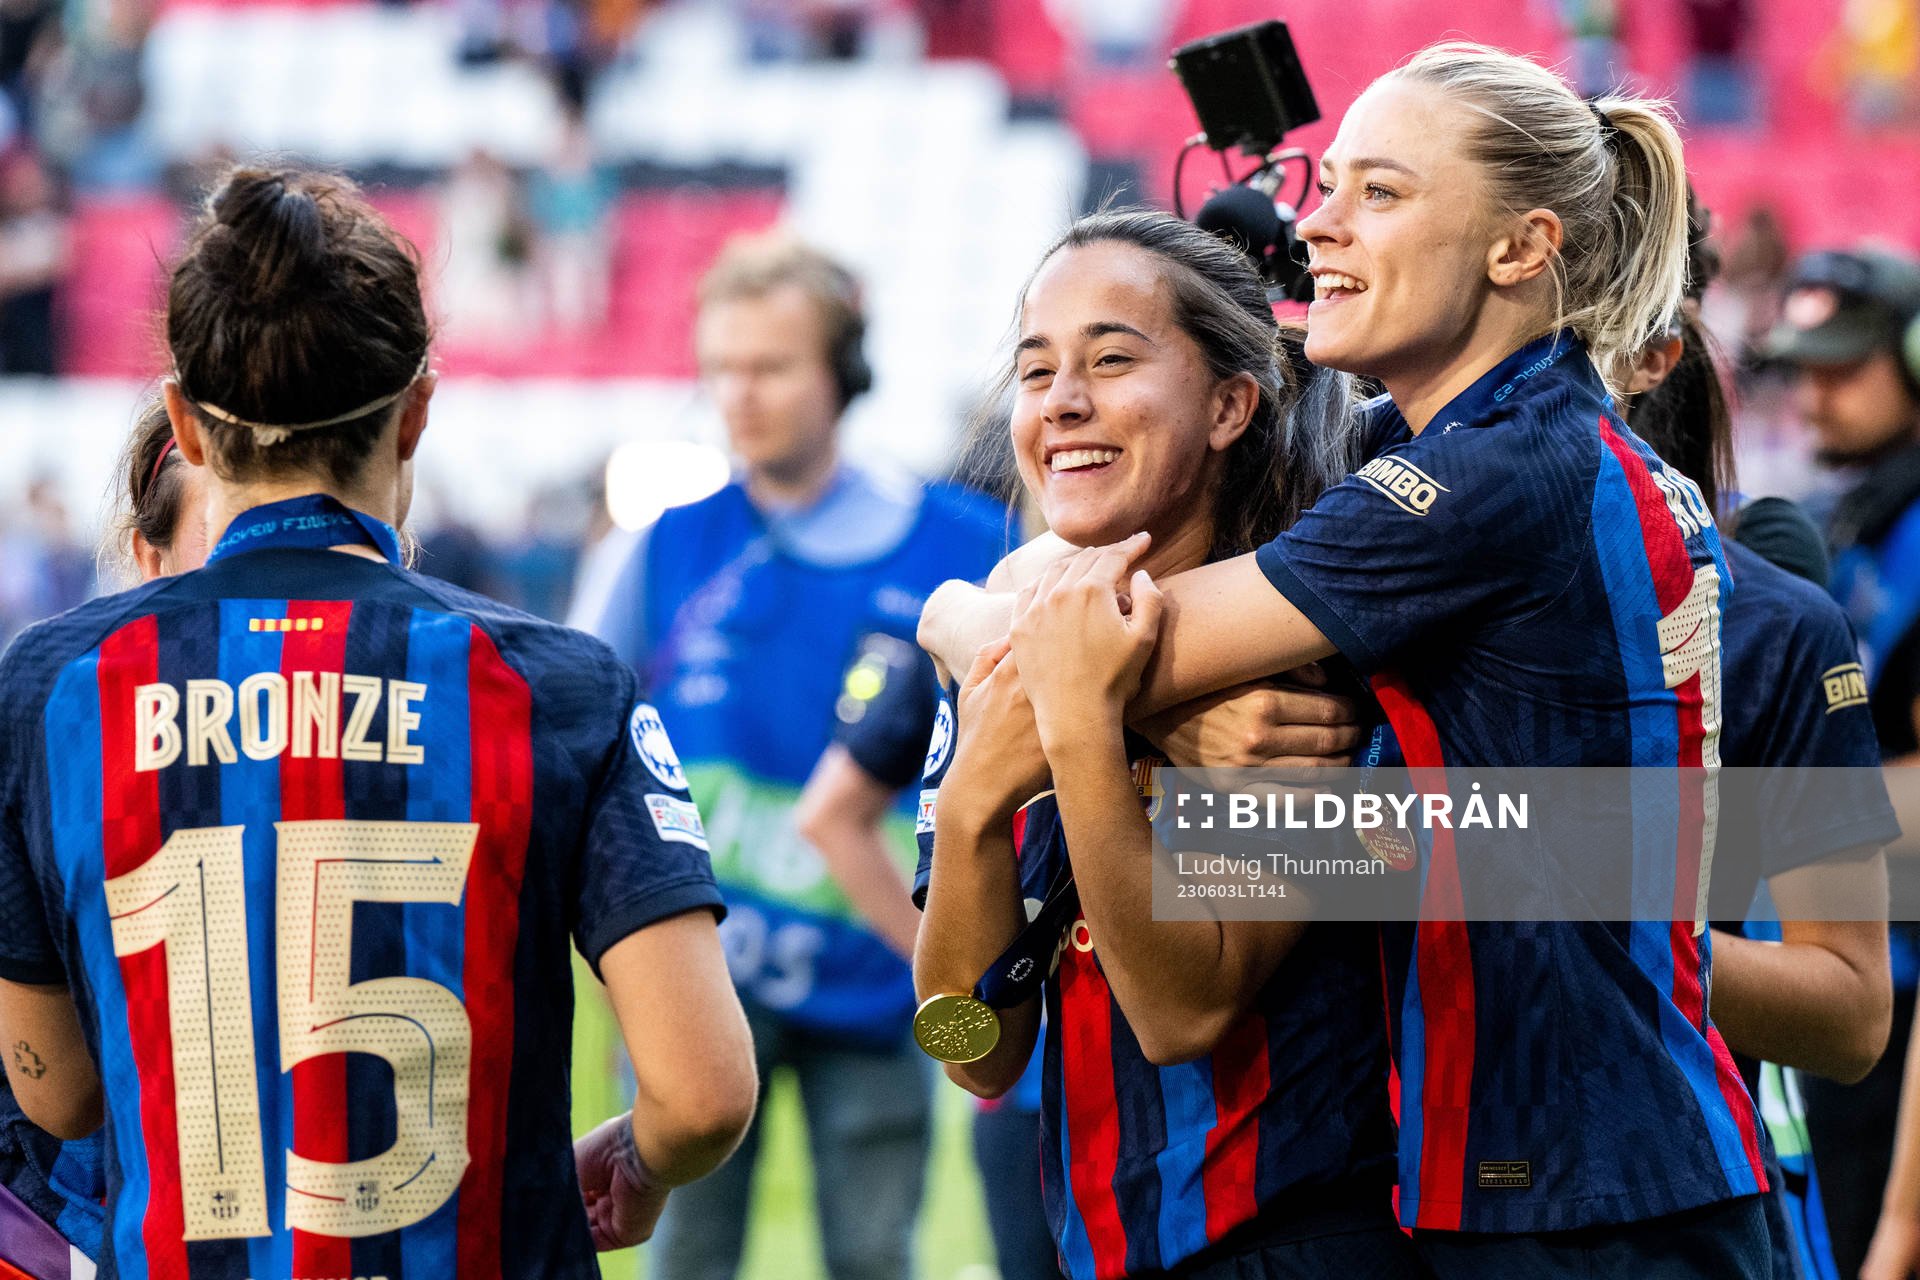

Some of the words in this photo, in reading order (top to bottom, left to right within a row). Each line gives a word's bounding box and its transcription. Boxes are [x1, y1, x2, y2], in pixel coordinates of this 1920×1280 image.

[1354, 457, 1438, 511] BIMBO
[134, 670, 428, 773] BRONZE
[103, 819, 481, 1242] 15
